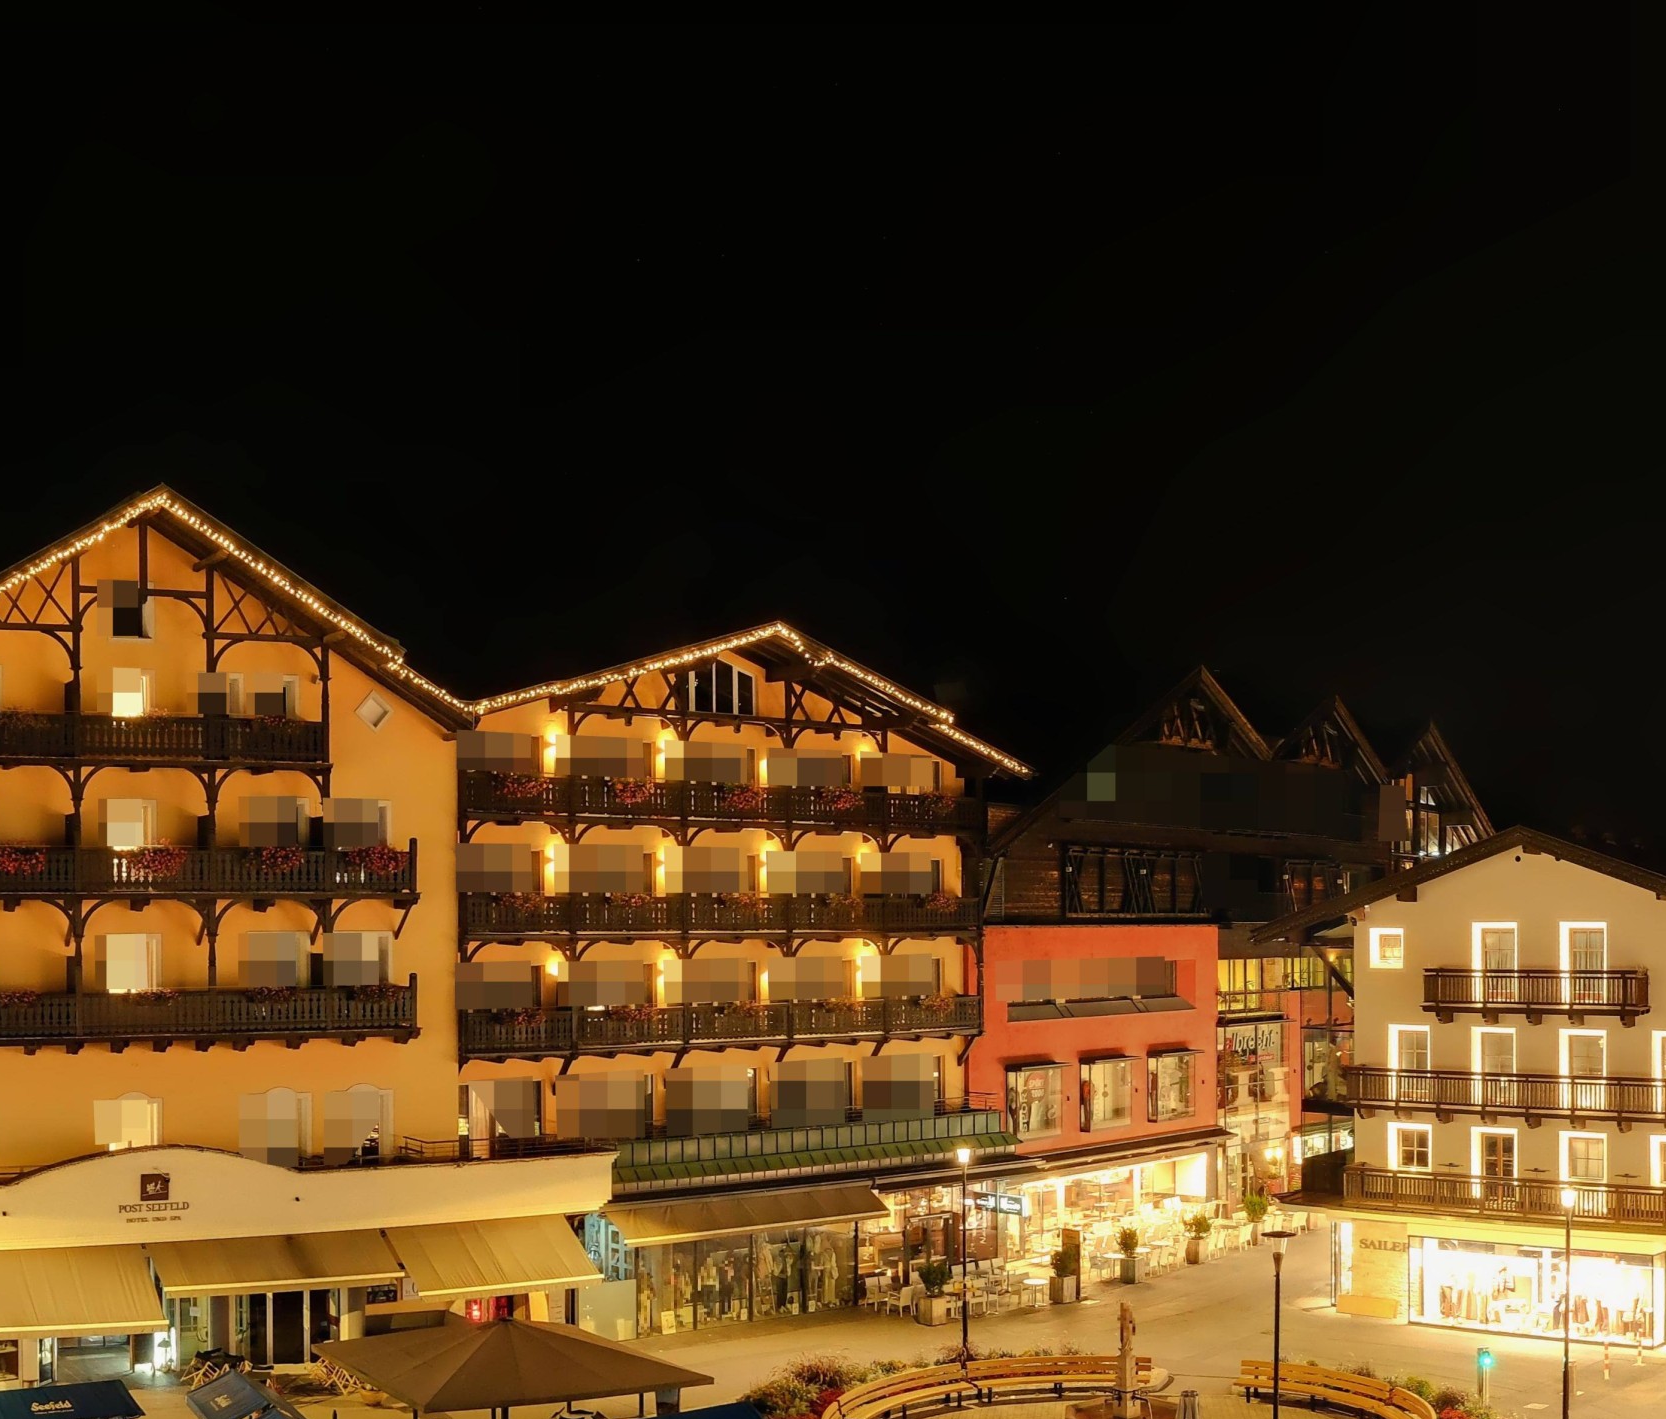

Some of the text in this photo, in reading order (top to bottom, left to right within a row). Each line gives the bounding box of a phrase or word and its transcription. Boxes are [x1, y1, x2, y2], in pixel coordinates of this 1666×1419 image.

[119, 1201, 191, 1214] POST SEEFELD
[30, 1400, 73, 1412] Seefeld
